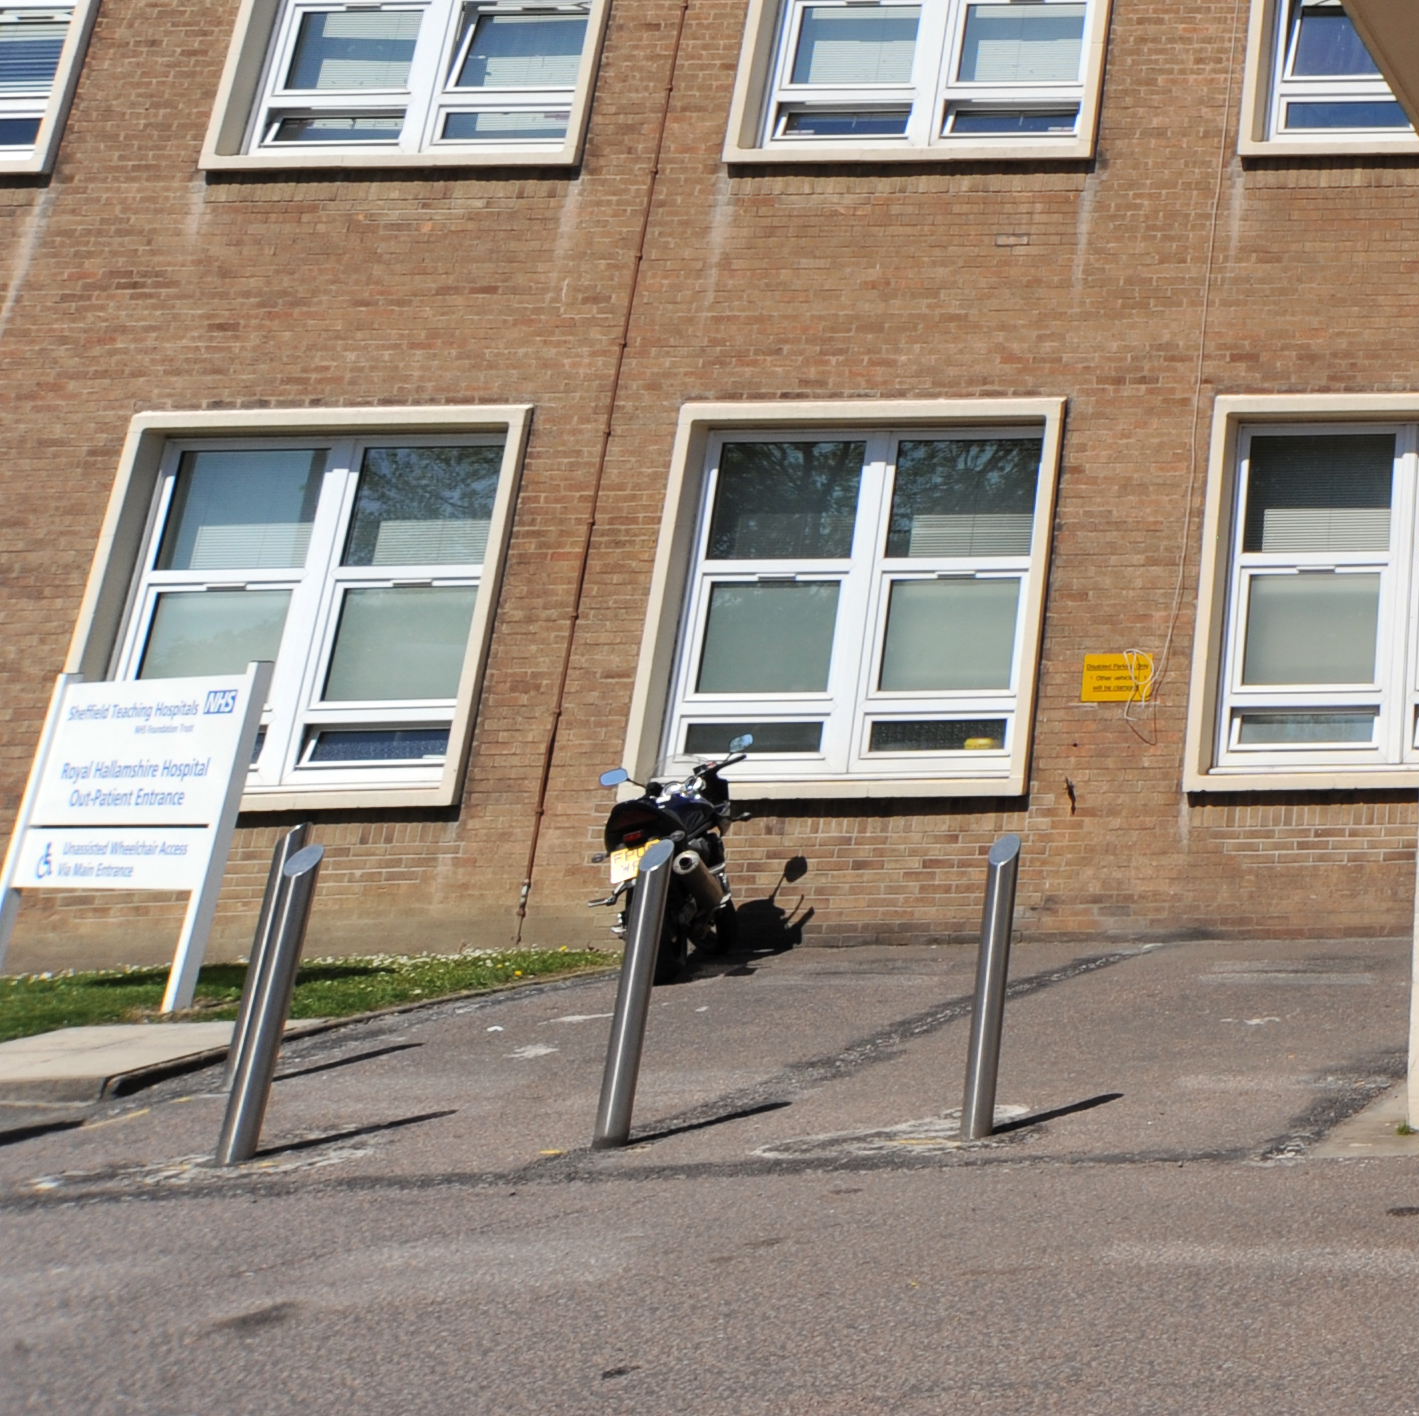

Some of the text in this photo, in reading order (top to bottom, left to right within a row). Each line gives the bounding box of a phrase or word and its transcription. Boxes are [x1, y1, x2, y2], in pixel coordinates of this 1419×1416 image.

[67, 698, 199, 721] Sheffield Teaching Hospitals
[204, 690, 237, 714] NHS
[61, 757, 211, 784] Royal Hallamshire Hospital
[68, 788, 185, 807] Out-Patient Entrance
[63, 840, 189, 855] Unassisted Wheelchair Access
[57, 862, 134, 877] Via Main Entrance
